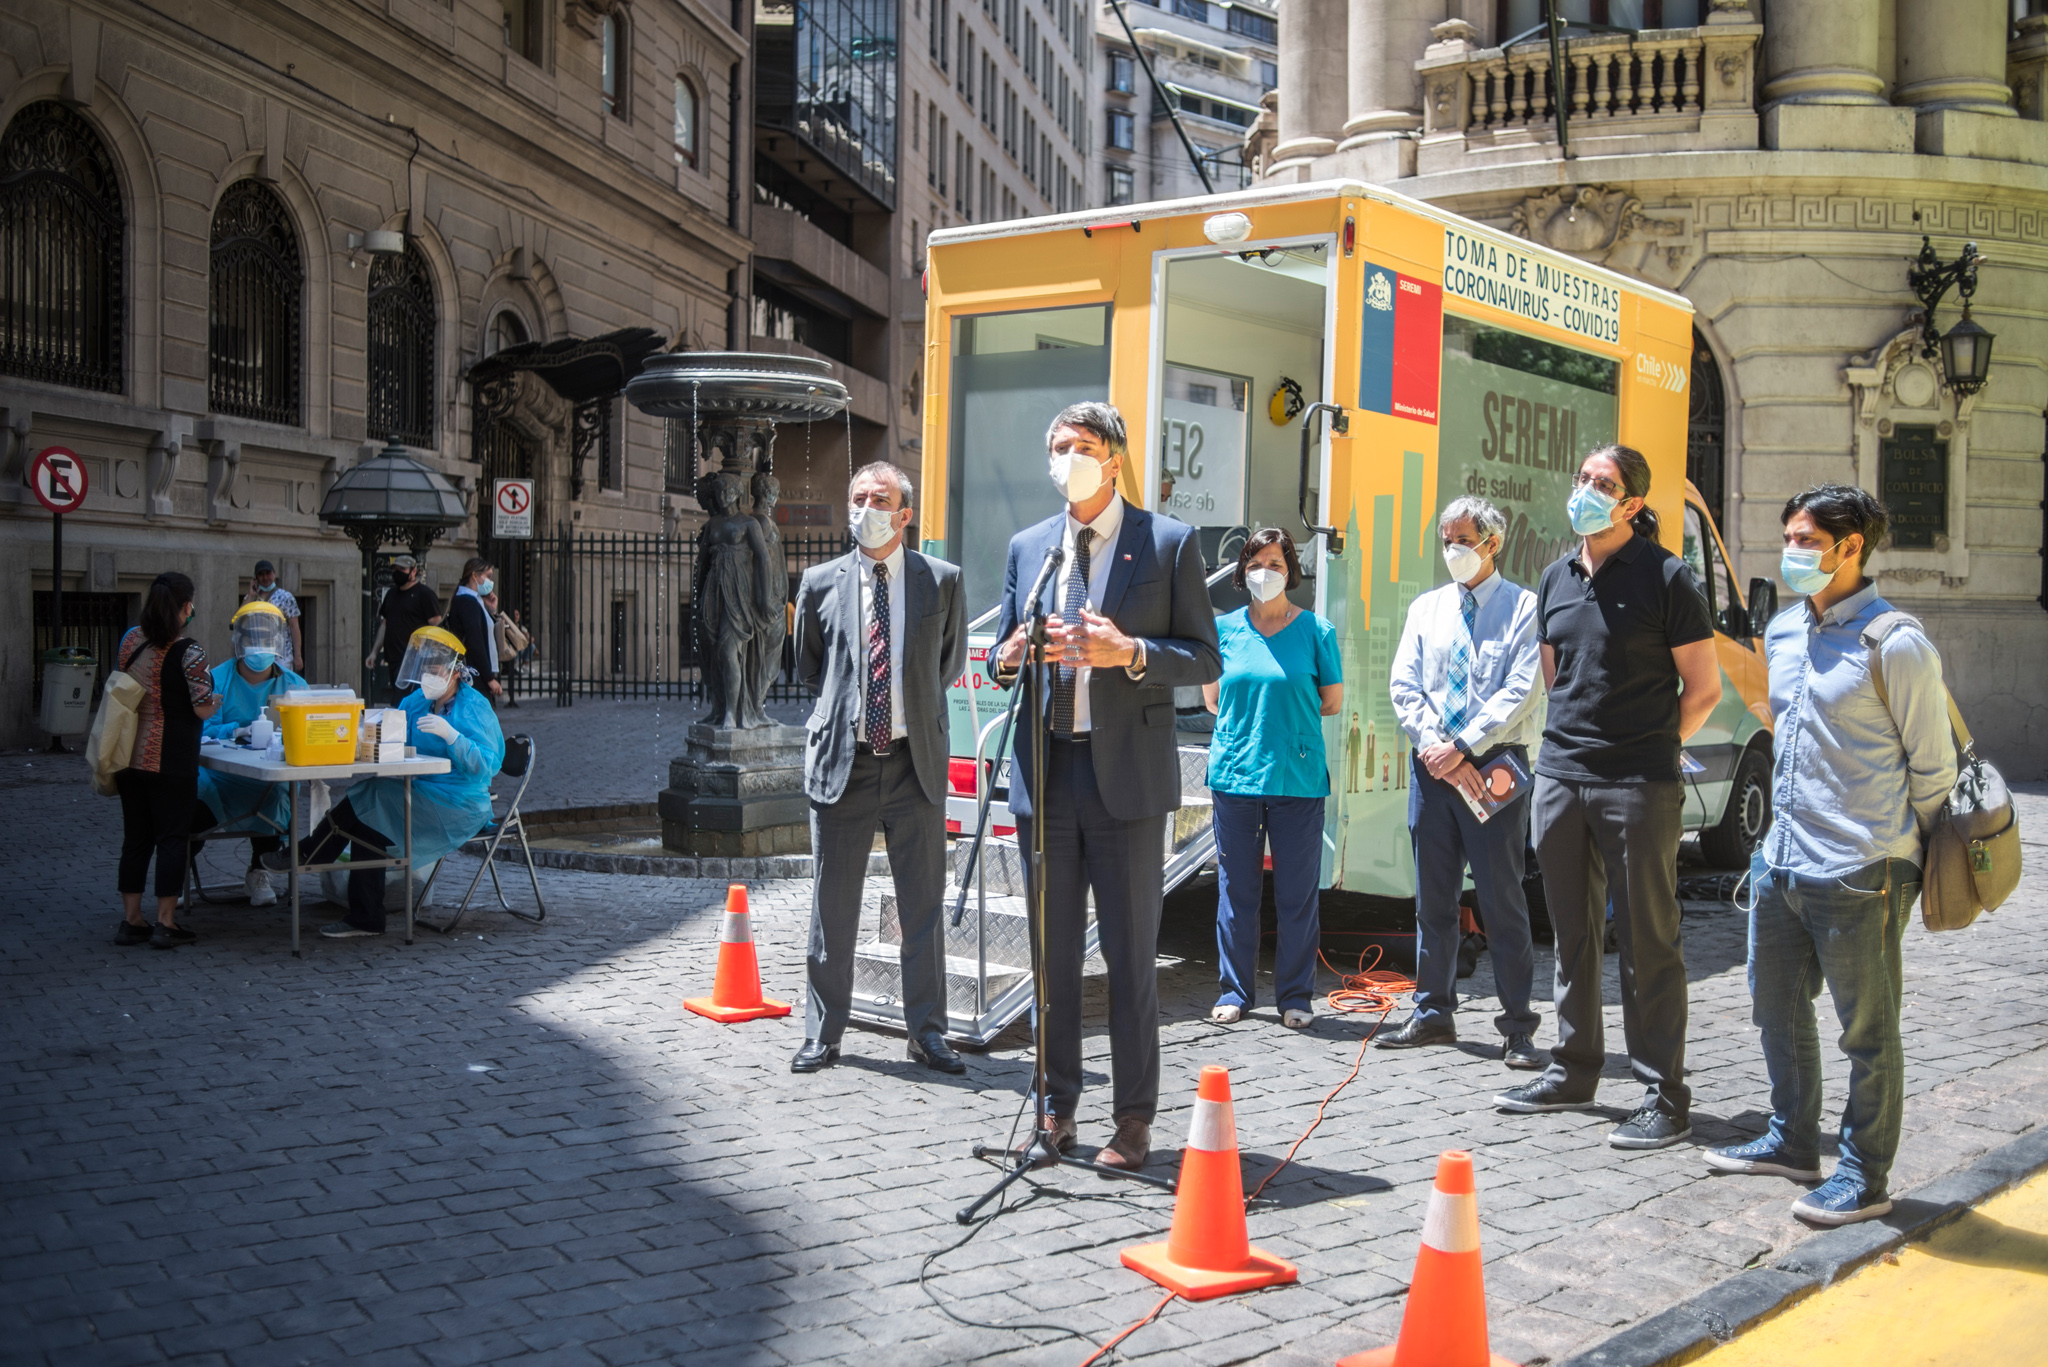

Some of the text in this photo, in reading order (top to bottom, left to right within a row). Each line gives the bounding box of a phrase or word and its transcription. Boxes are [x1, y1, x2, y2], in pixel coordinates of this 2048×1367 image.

[1446, 230, 1619, 313] TOMA DE MUESTRAS
[1399, 279, 1422, 296] SEREMI
[1445, 265, 1550, 322] CORONAVIRUS
[1563, 305, 1619, 343] COVID19
[1636, 352, 1661, 378] Chile
[1394, 402, 1436, 419] Ministerio de Salud
[1482, 390, 1577, 474] SEREMI
[1893, 449, 1938, 461] BOLSA
[1467, 469, 1532, 502] de salud
[1886, 481, 1944, 494] COMERCIO
[953, 698, 987, 707] PROFESALES
